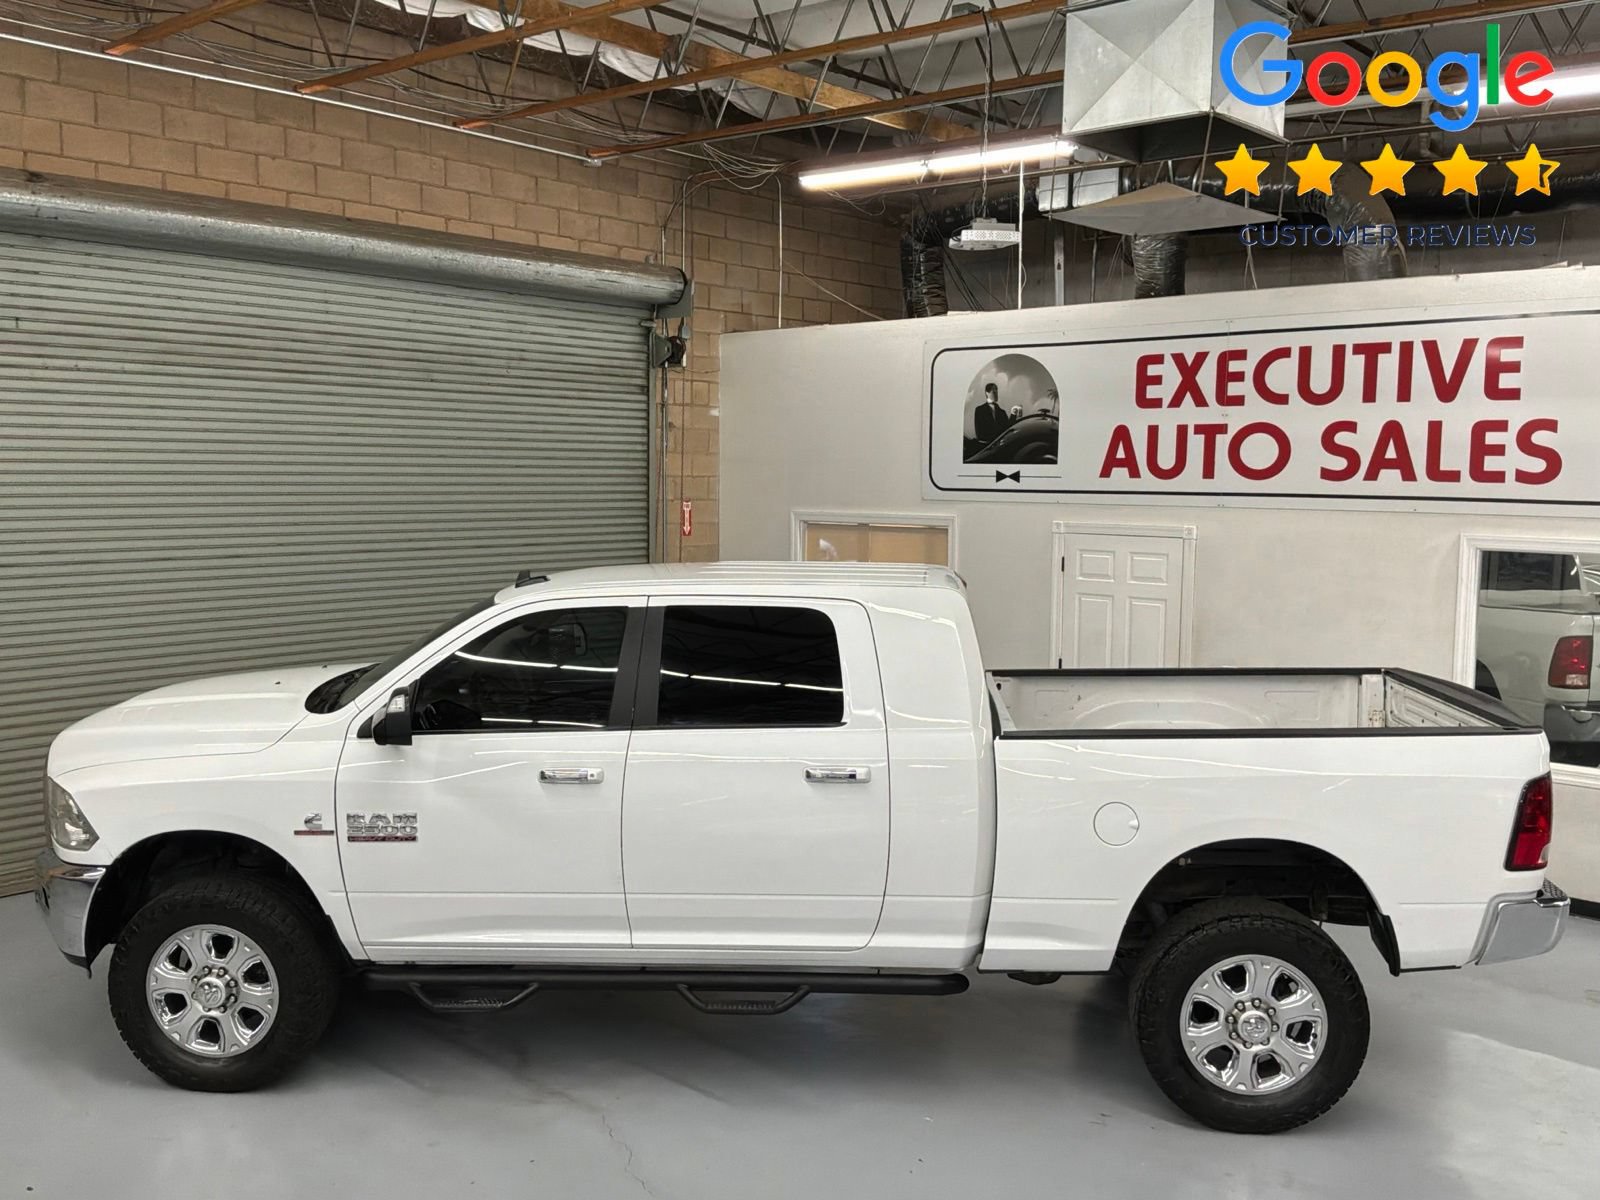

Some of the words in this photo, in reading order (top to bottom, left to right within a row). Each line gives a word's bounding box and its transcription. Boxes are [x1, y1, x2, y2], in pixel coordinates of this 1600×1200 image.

[1135, 336, 1524, 409] EXECUTIVE
[1099, 420, 1292, 480] AUTO
[1319, 417, 1563, 486] SALES
[346, 812, 418, 825] RAM
